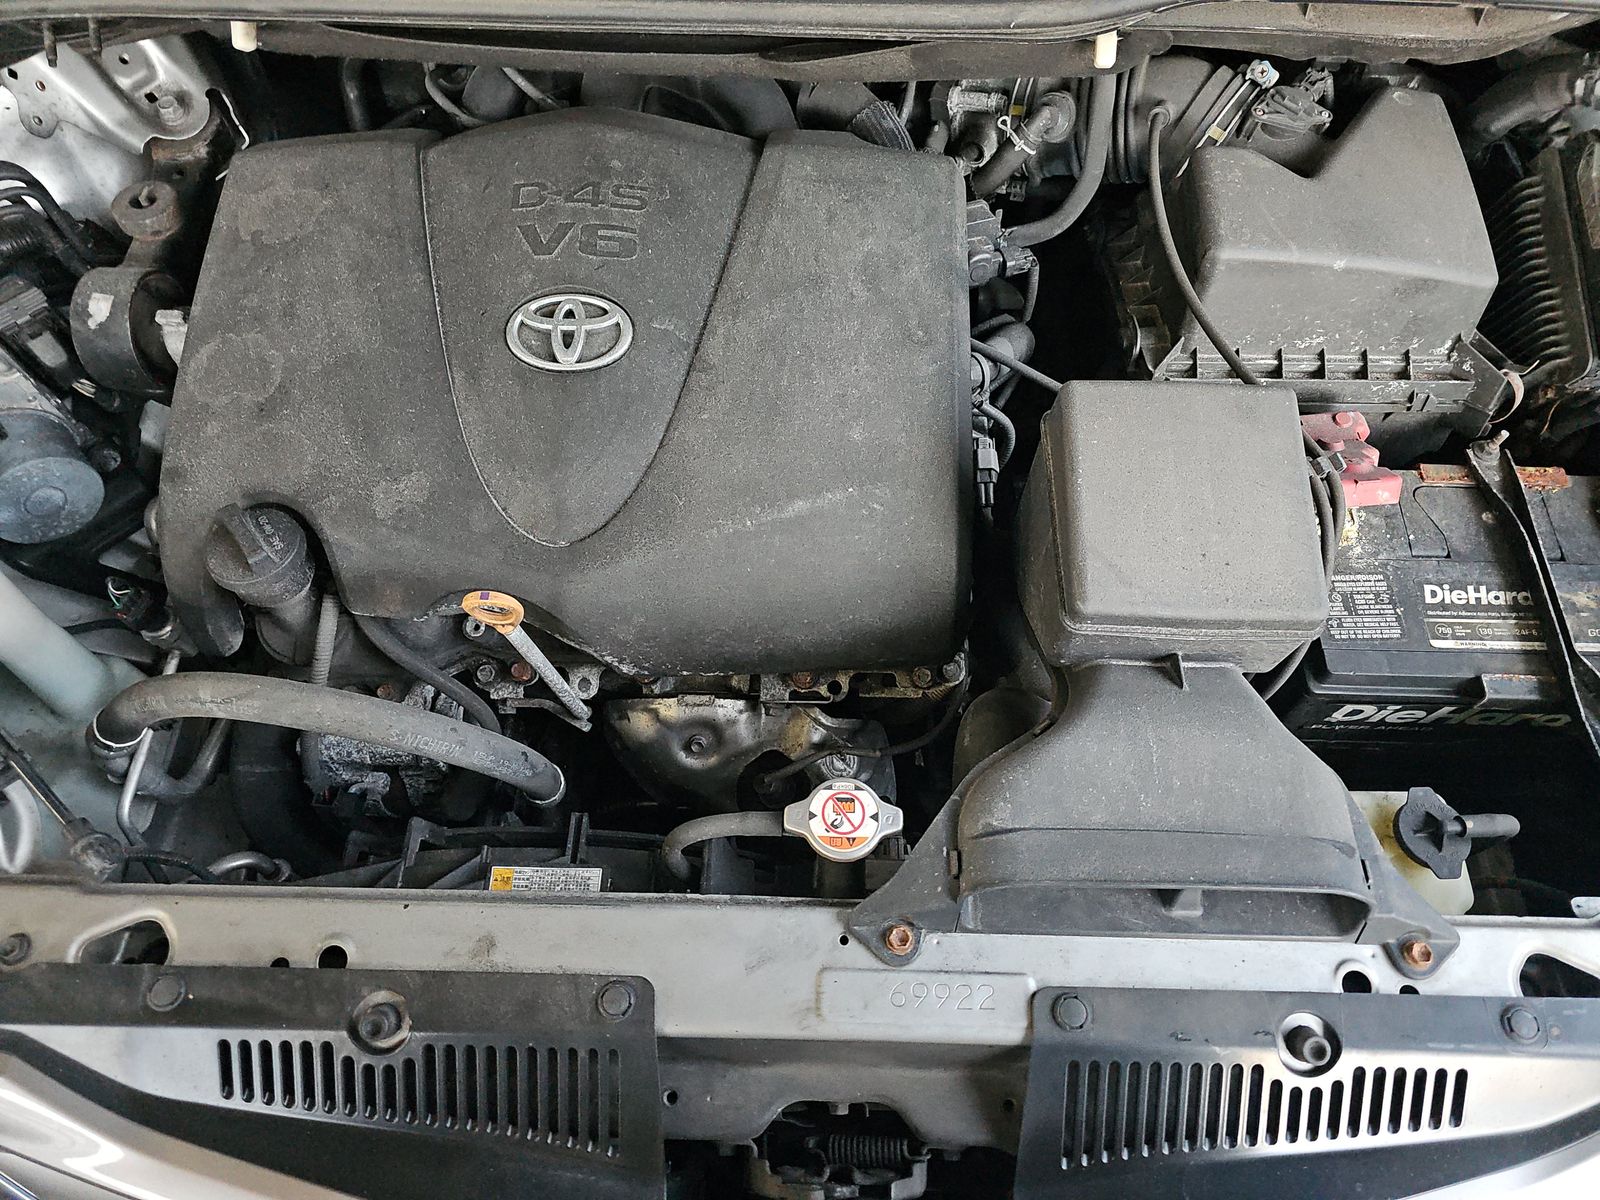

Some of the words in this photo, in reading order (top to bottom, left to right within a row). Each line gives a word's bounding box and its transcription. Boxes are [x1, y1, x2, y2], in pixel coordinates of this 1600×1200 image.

[511, 181, 651, 212] D-4S
[516, 220, 639, 260] V6
[268, 535, 284, 550] SAE
[1423, 584, 1534, 606] DieHard
[1478, 627, 1493, 635] 130
[888, 981, 996, 1011] 69922
